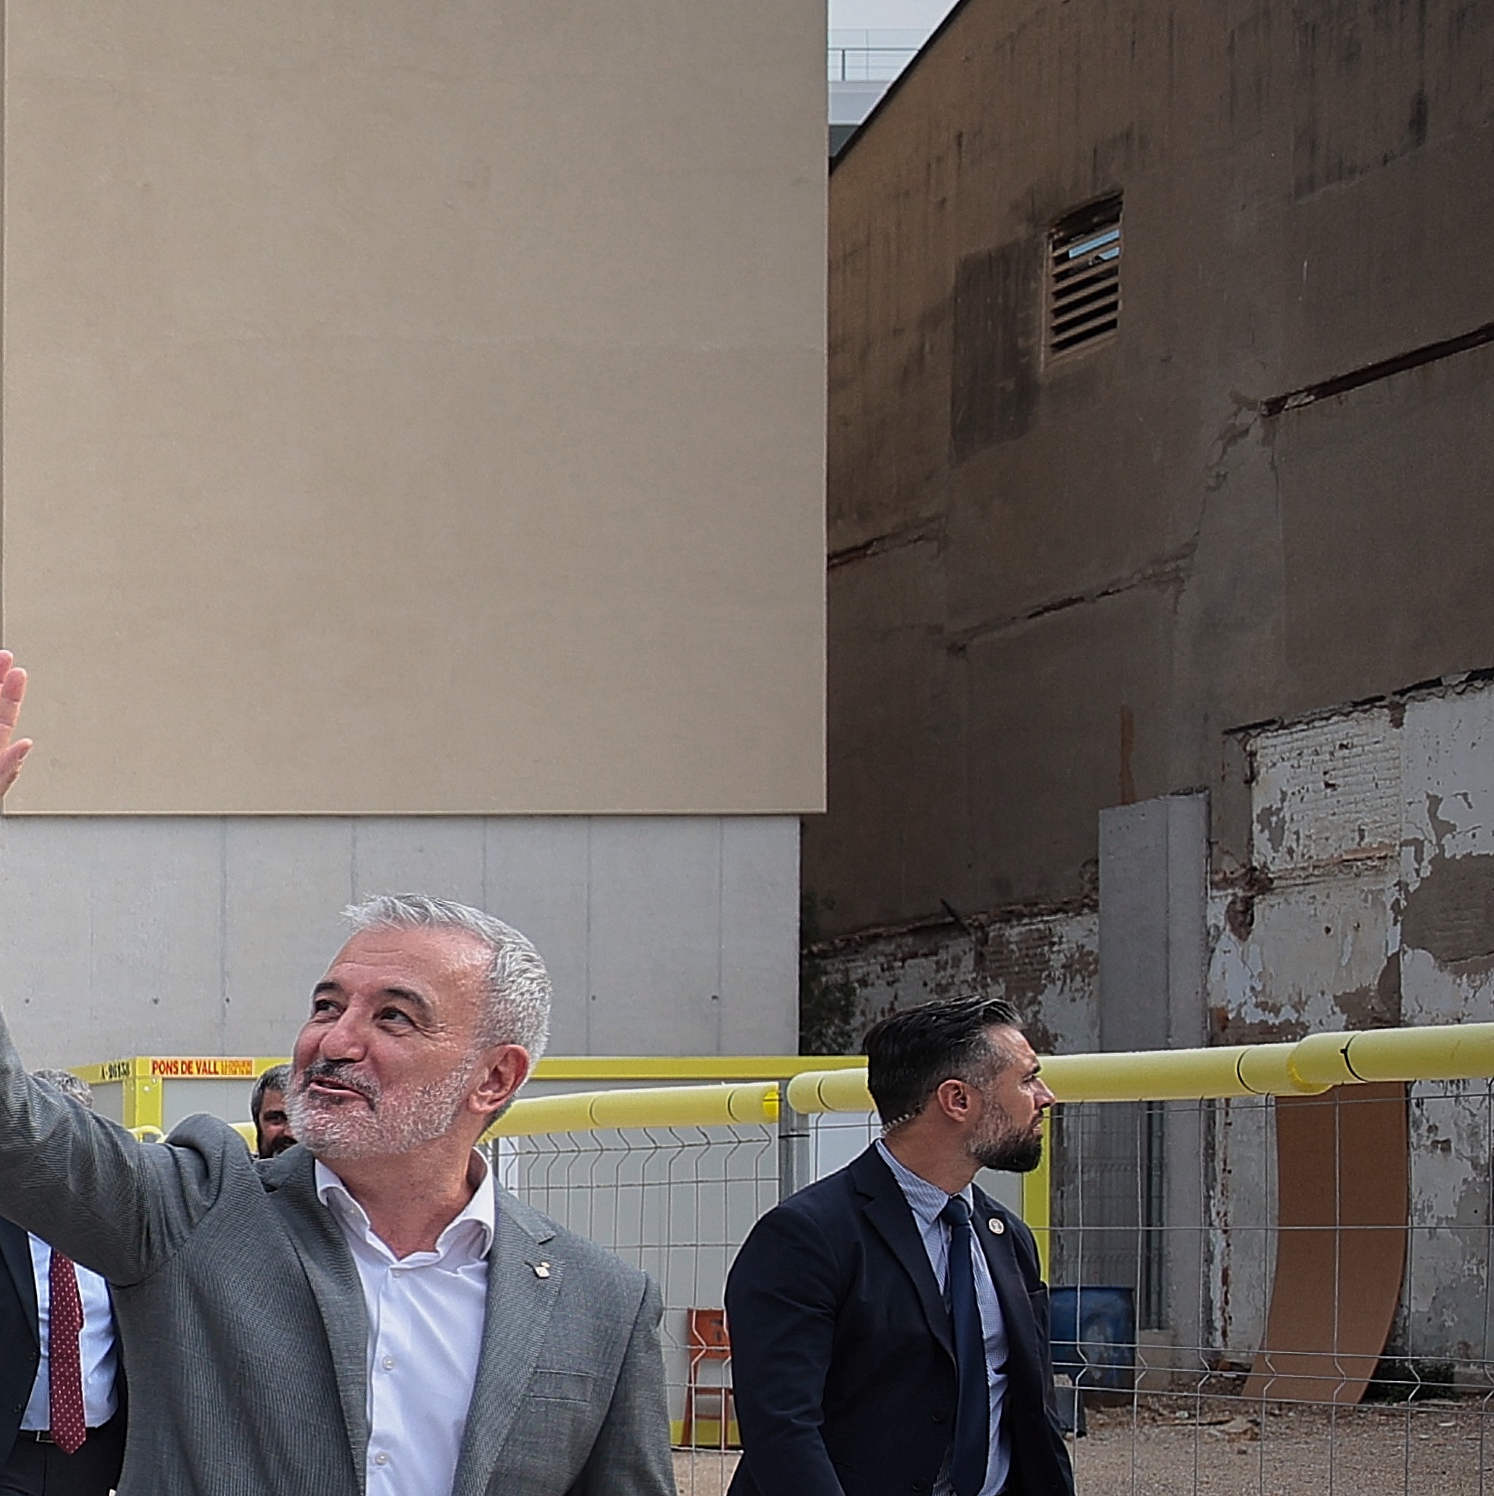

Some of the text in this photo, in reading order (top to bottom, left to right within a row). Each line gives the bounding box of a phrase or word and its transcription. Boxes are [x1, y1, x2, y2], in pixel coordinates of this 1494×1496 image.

[152, 1060, 179, 1075] PONS
[181, 1060, 193, 1075] DE
[195, 1060, 219, 1075] VALL
